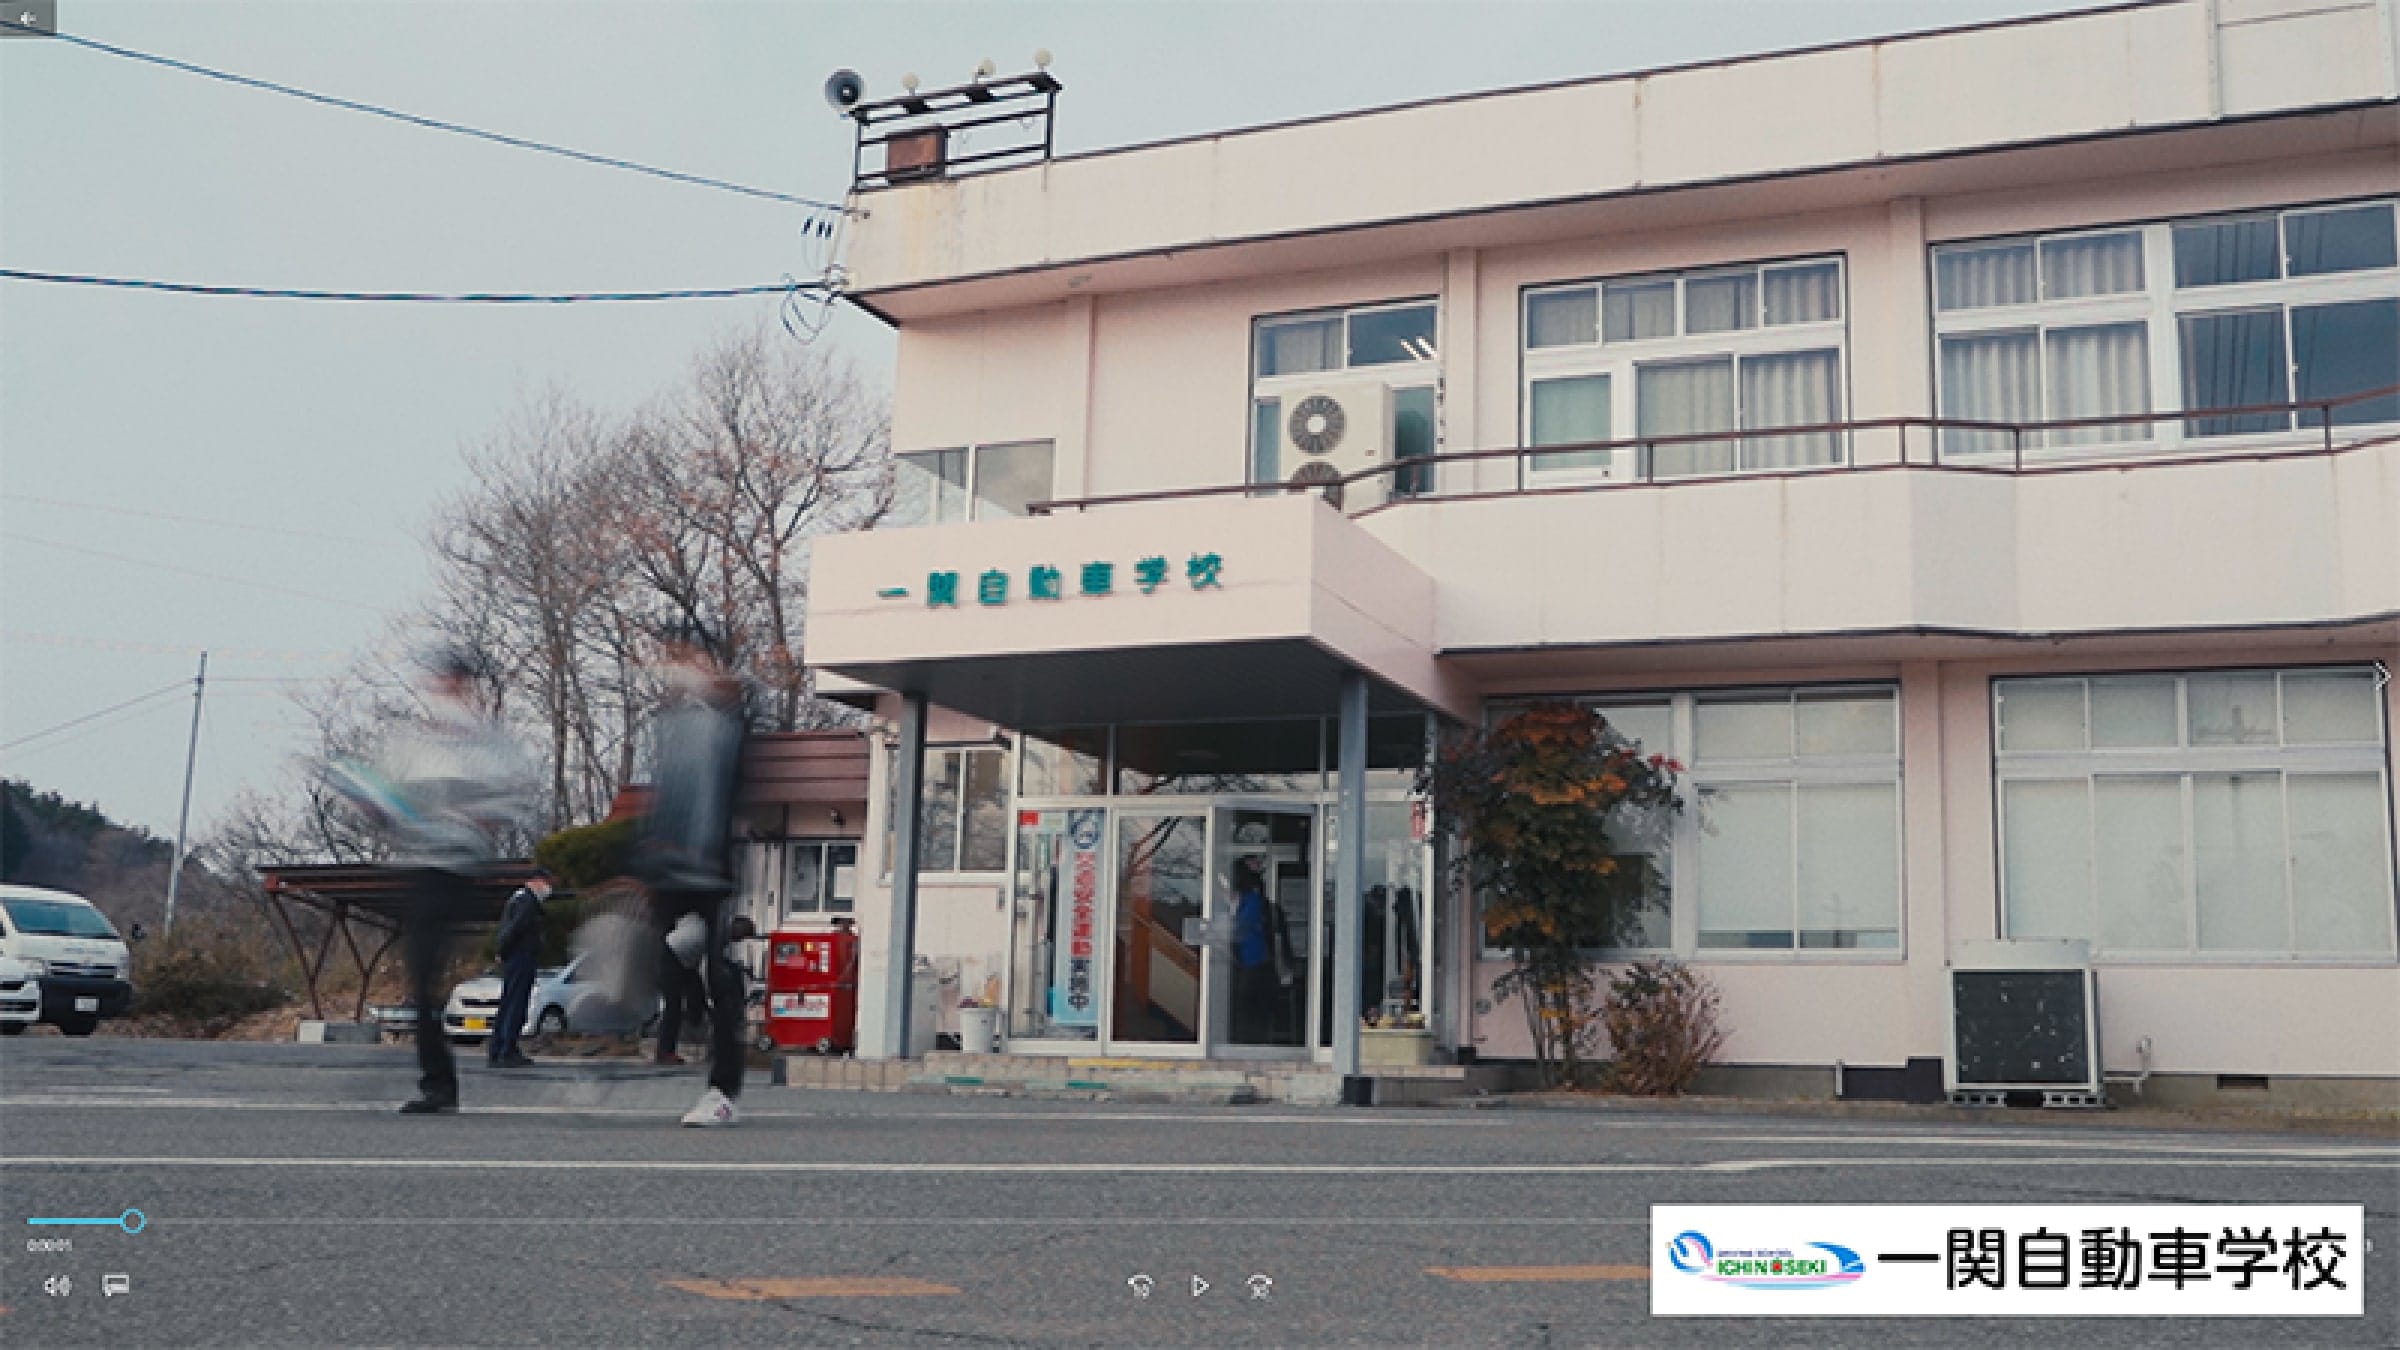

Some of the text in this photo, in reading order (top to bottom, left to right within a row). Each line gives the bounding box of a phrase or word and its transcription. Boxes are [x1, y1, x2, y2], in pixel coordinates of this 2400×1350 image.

[876, 551, 1223, 607] 一関自動車学校
